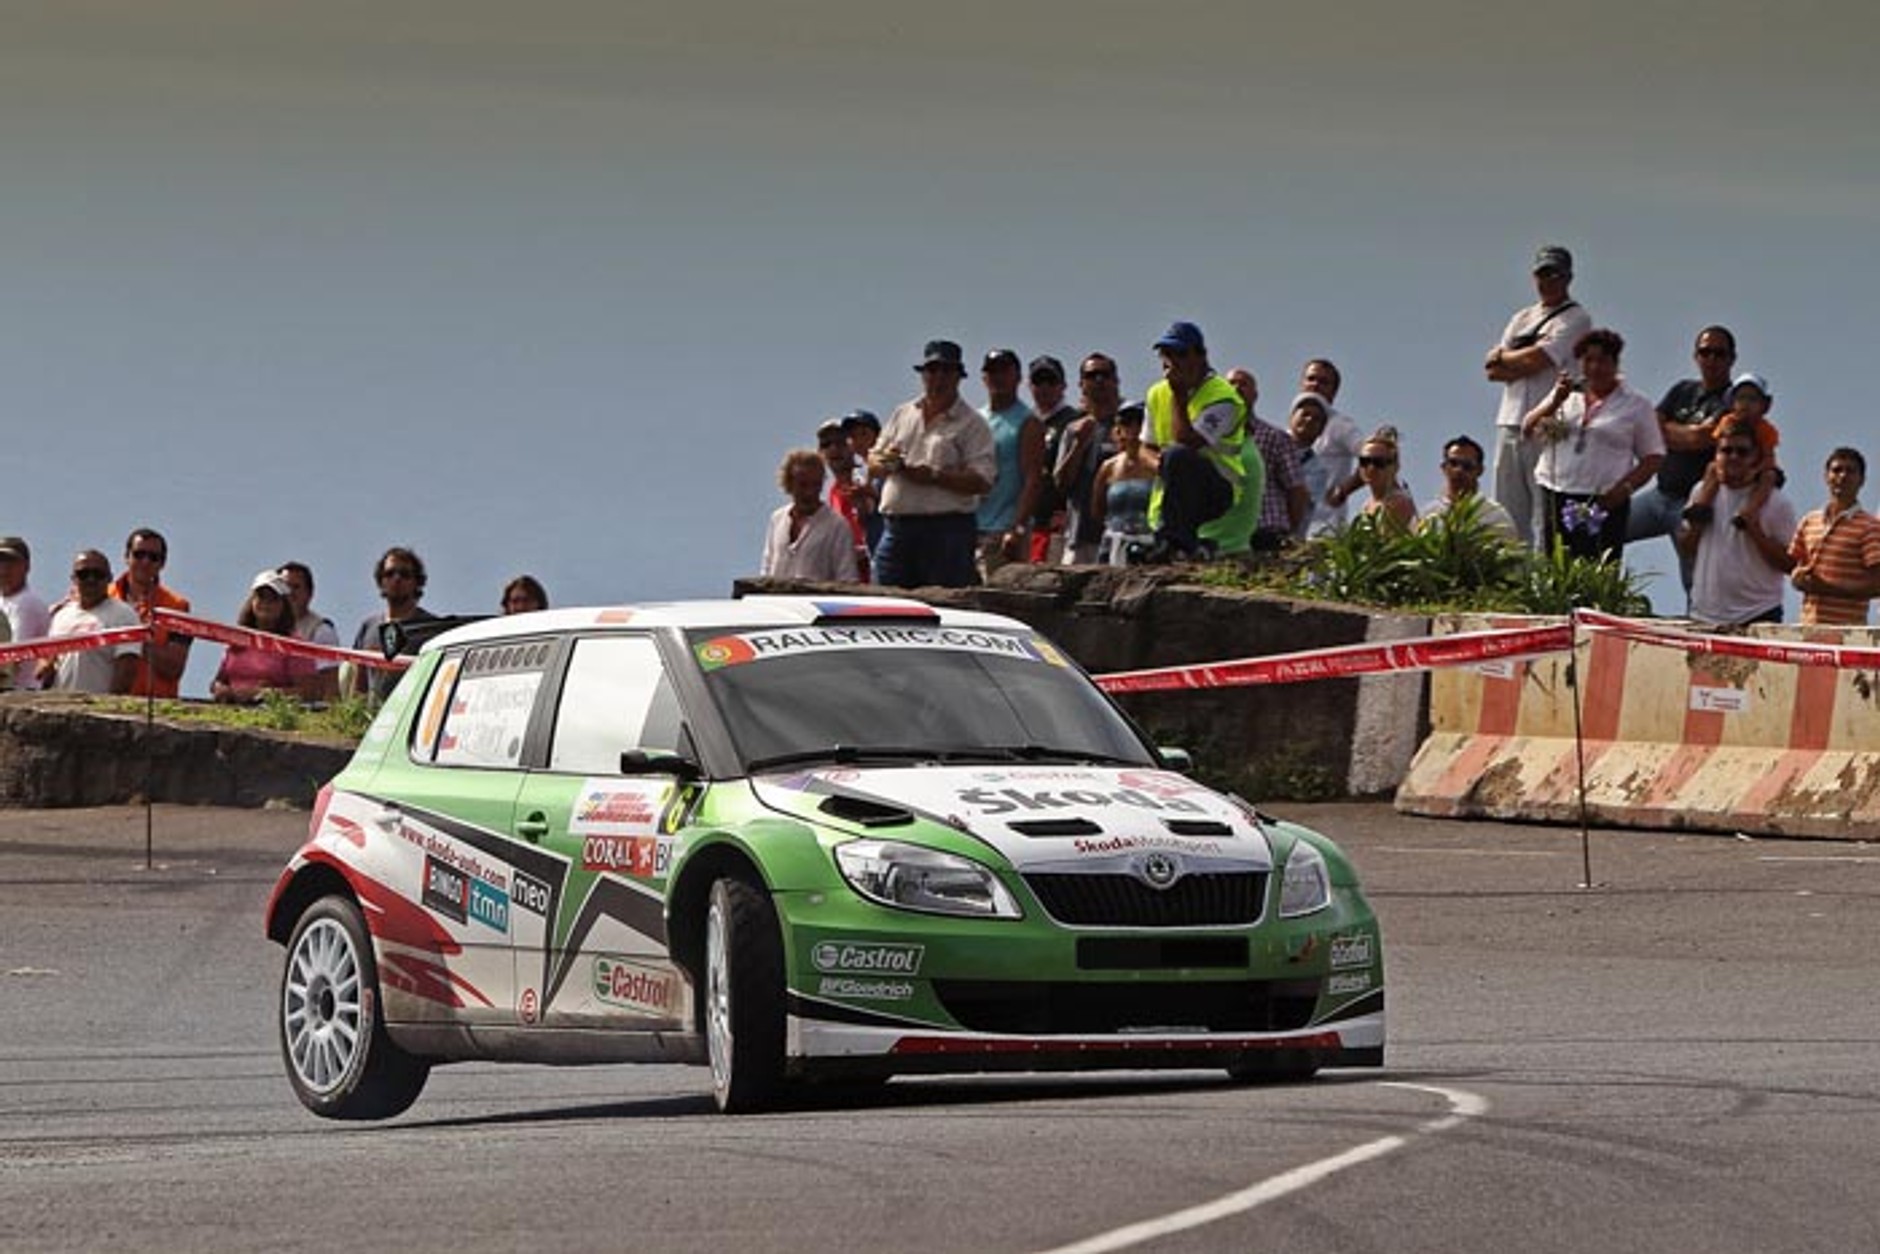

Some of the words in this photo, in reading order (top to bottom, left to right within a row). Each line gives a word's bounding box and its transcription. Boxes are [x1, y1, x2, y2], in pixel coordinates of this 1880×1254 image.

[750, 627, 1025, 655] RALLY-IRC.COM
[583, 837, 633, 868] CORAL
[471, 886, 507, 928] tmn
[512, 877, 547, 912] meo
[840, 946, 915, 971] Castrol
[612, 964, 670, 1008] Castrol
